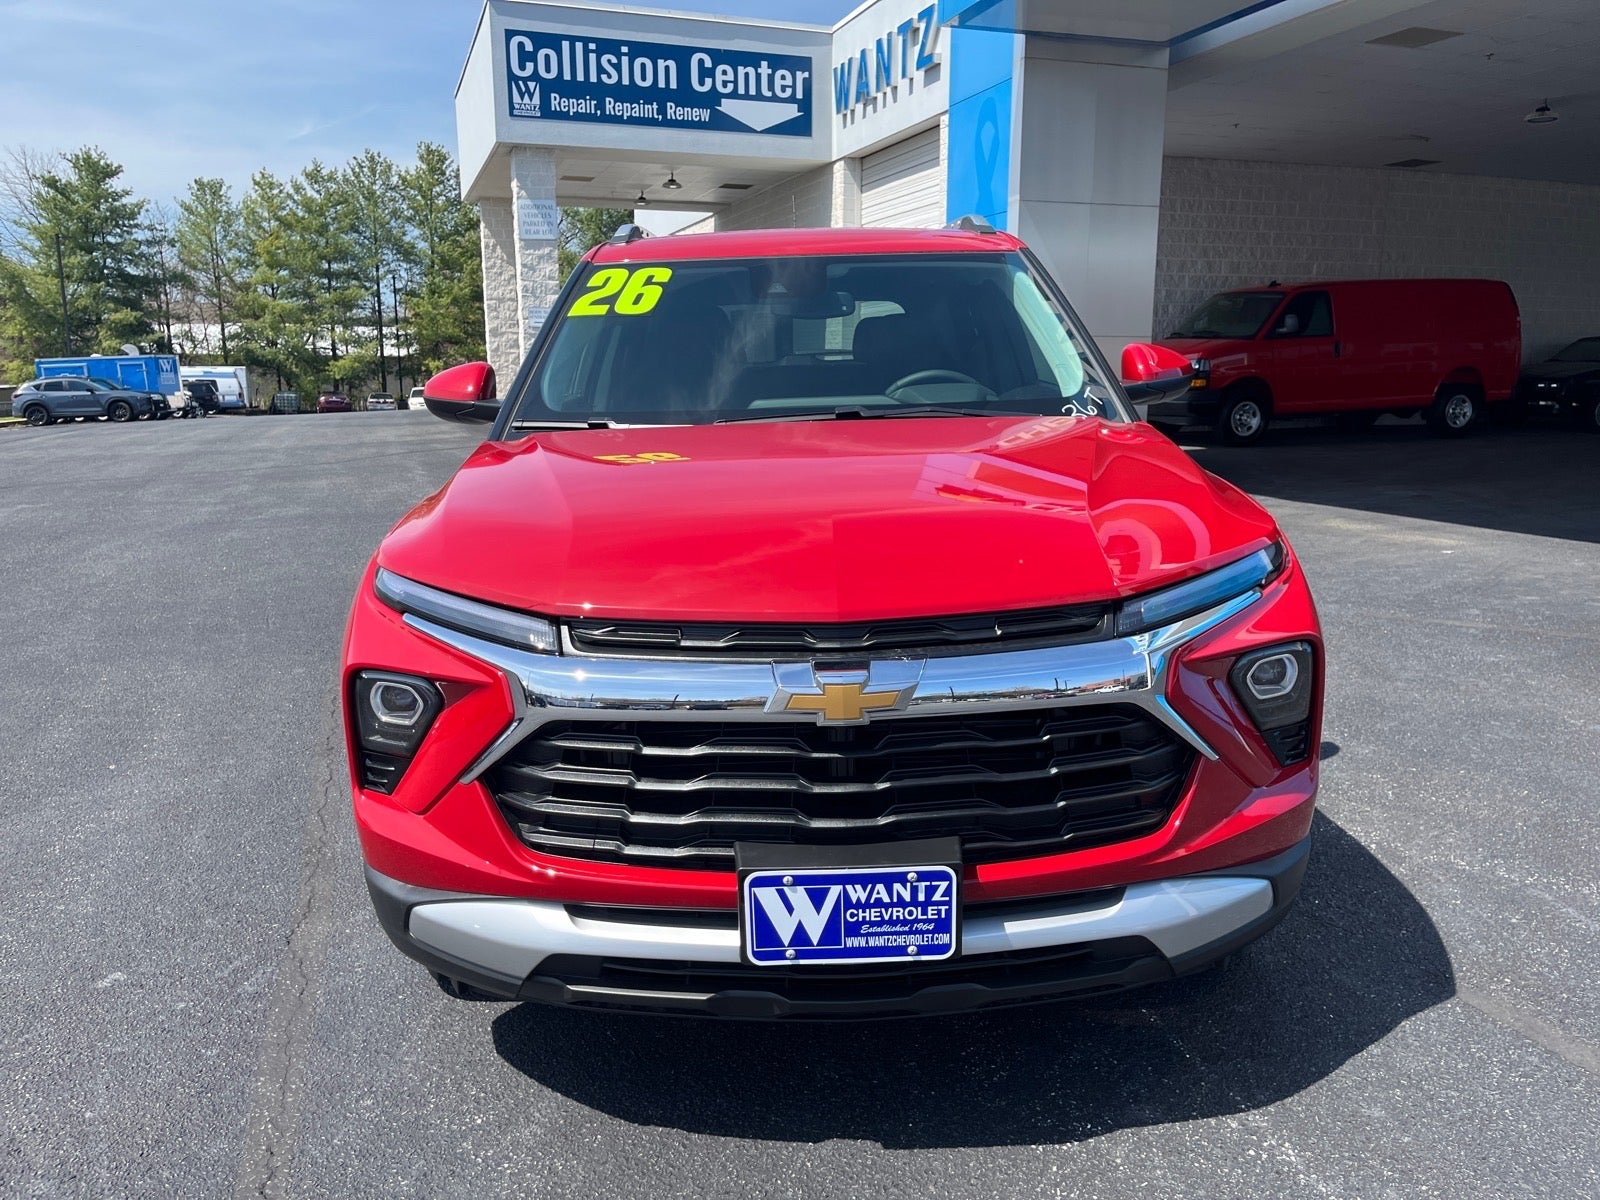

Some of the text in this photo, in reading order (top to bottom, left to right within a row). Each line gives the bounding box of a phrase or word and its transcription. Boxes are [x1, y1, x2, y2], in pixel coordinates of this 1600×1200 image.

[509, 35, 809, 99] Collision Center
[833, 3, 937, 115] WANTZ
[513, 103, 540, 111] WANTZ
[551, 93, 710, 122] Repair, Repaint, Renew
[567, 267, 673, 317] 26
[845, 881, 950, 904] WANTZ
[846, 906, 949, 921] CHEVROLET
[861, 923, 935, 933] Established 1964
[845, 934, 950, 947] WWW.WANTZCHEVROLET.COM
